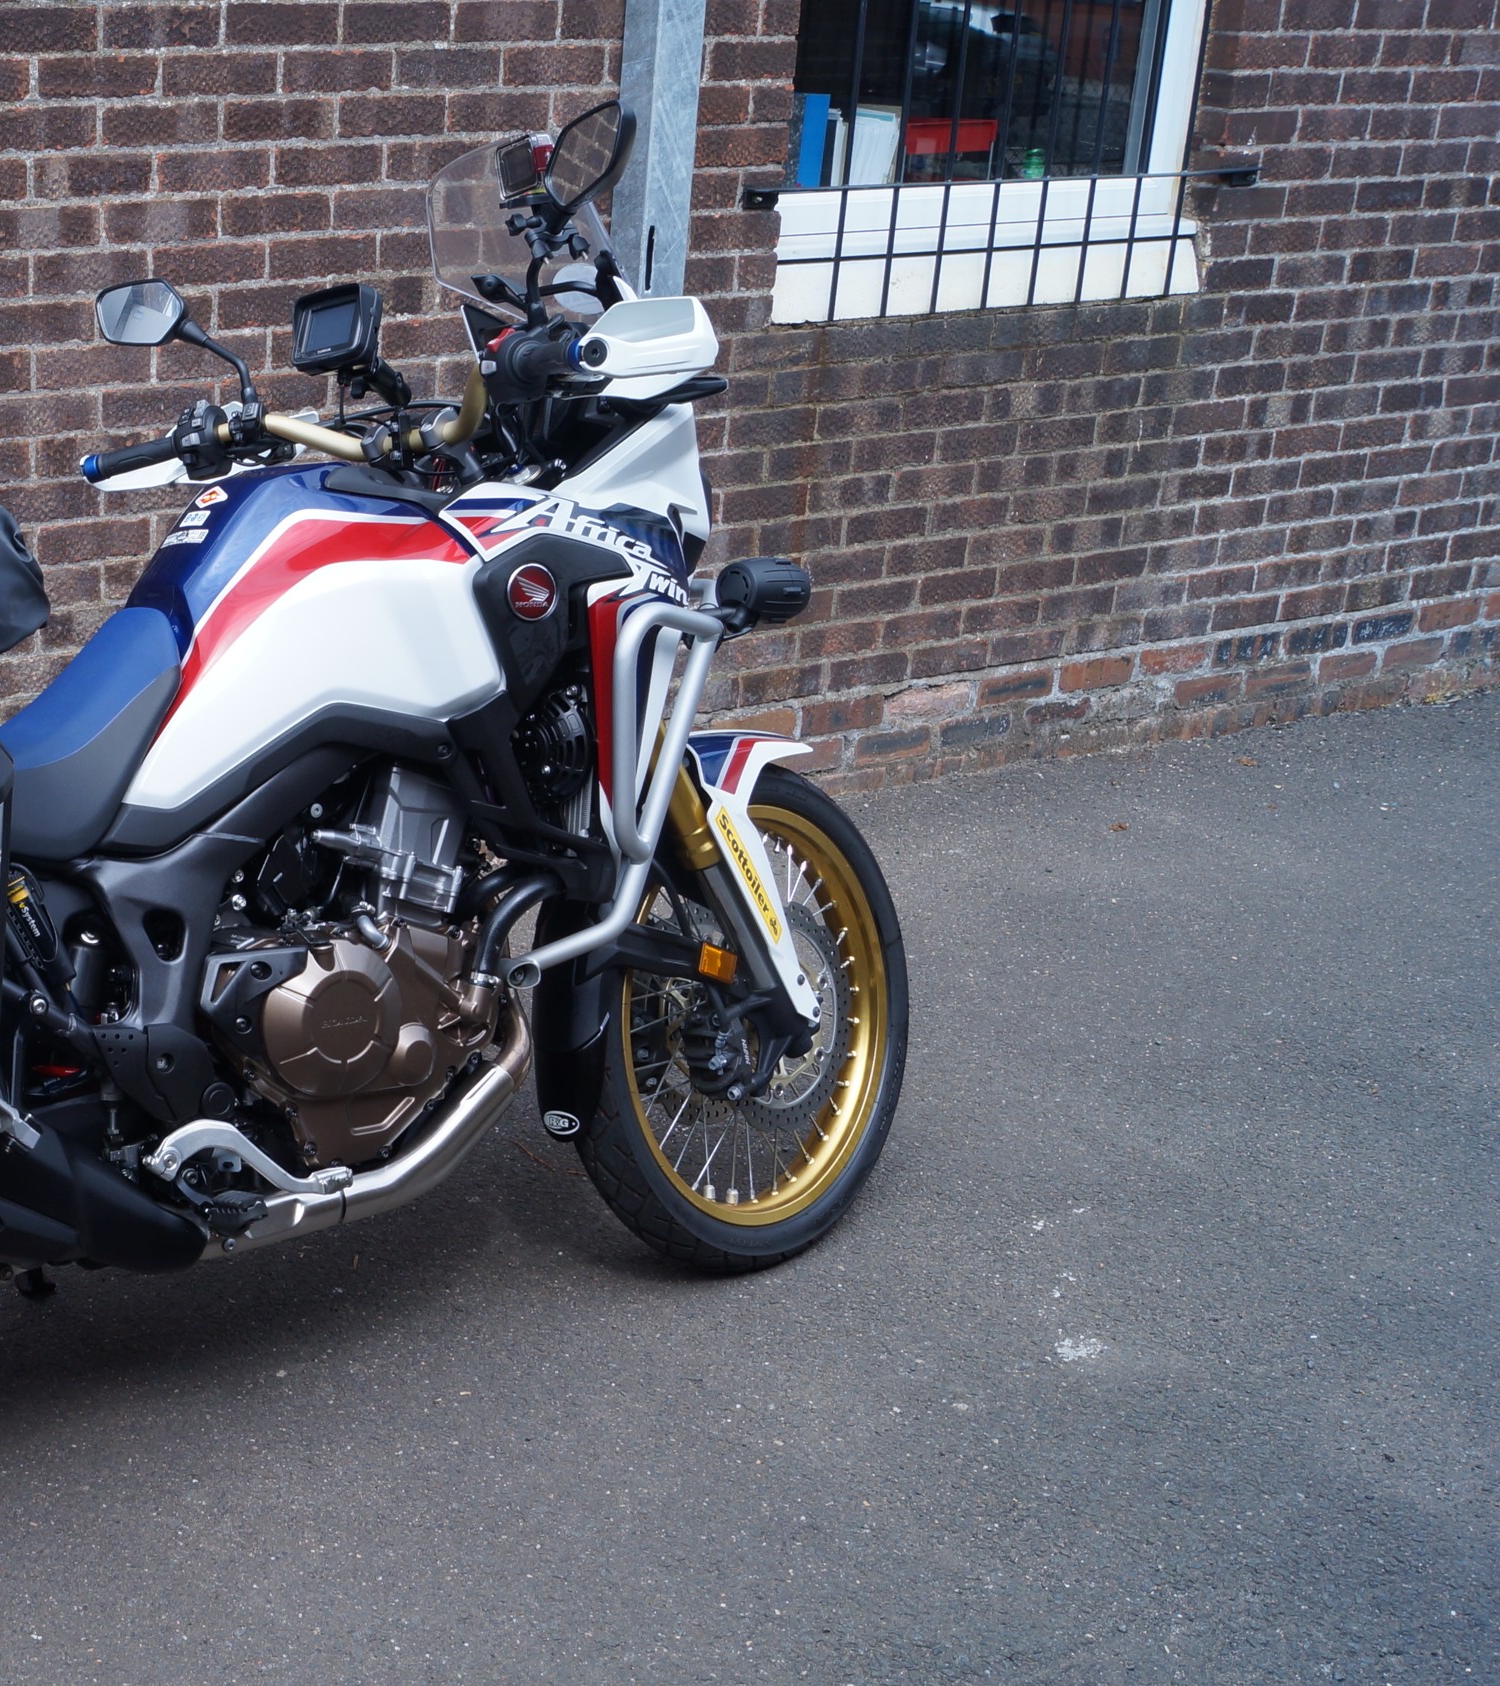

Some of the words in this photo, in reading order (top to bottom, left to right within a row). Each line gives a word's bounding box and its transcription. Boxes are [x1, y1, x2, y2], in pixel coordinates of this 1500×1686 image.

[491, 497, 668, 569] Africa
[618, 551, 689, 606] Twin
[719, 813, 770, 913] Scottoiler
